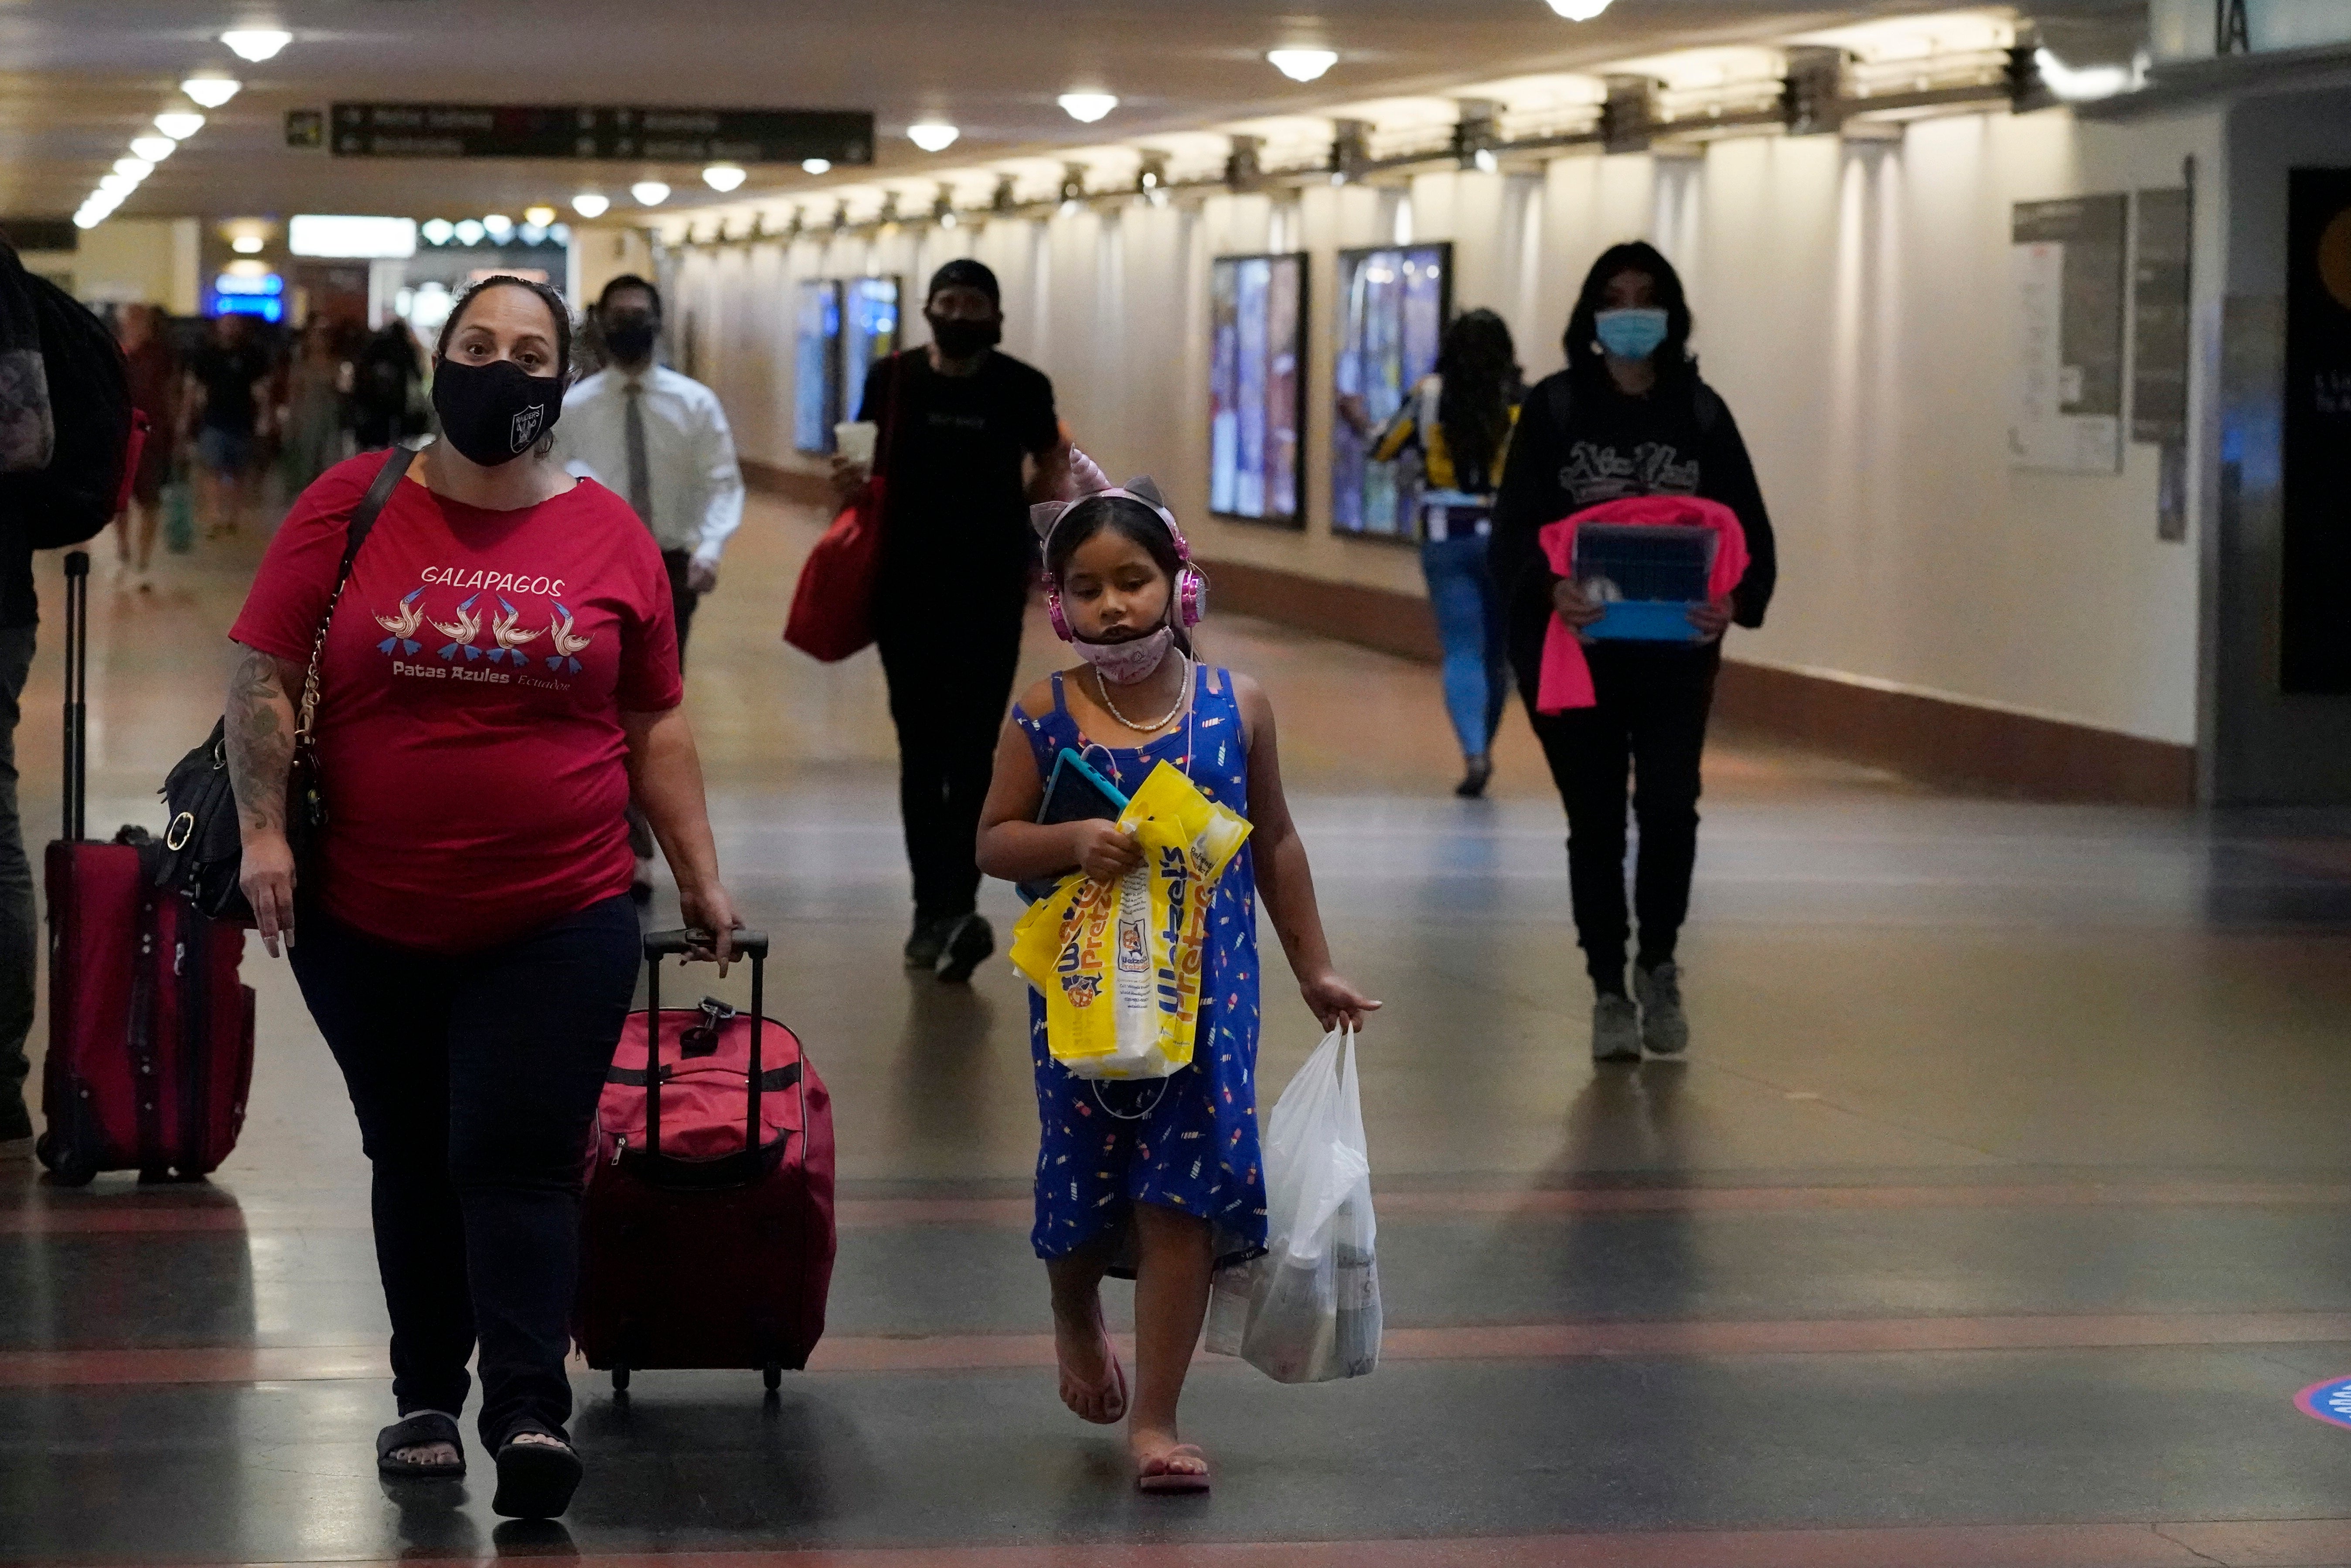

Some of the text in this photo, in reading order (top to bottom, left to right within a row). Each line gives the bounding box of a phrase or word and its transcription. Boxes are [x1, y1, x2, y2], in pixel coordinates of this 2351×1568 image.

[516, 410, 540, 423] RAIDERS
[421, 566, 566, 597] GALAPAGOS
[393, 661, 446, 678] Patas
[451, 666, 510, 684] Azules
